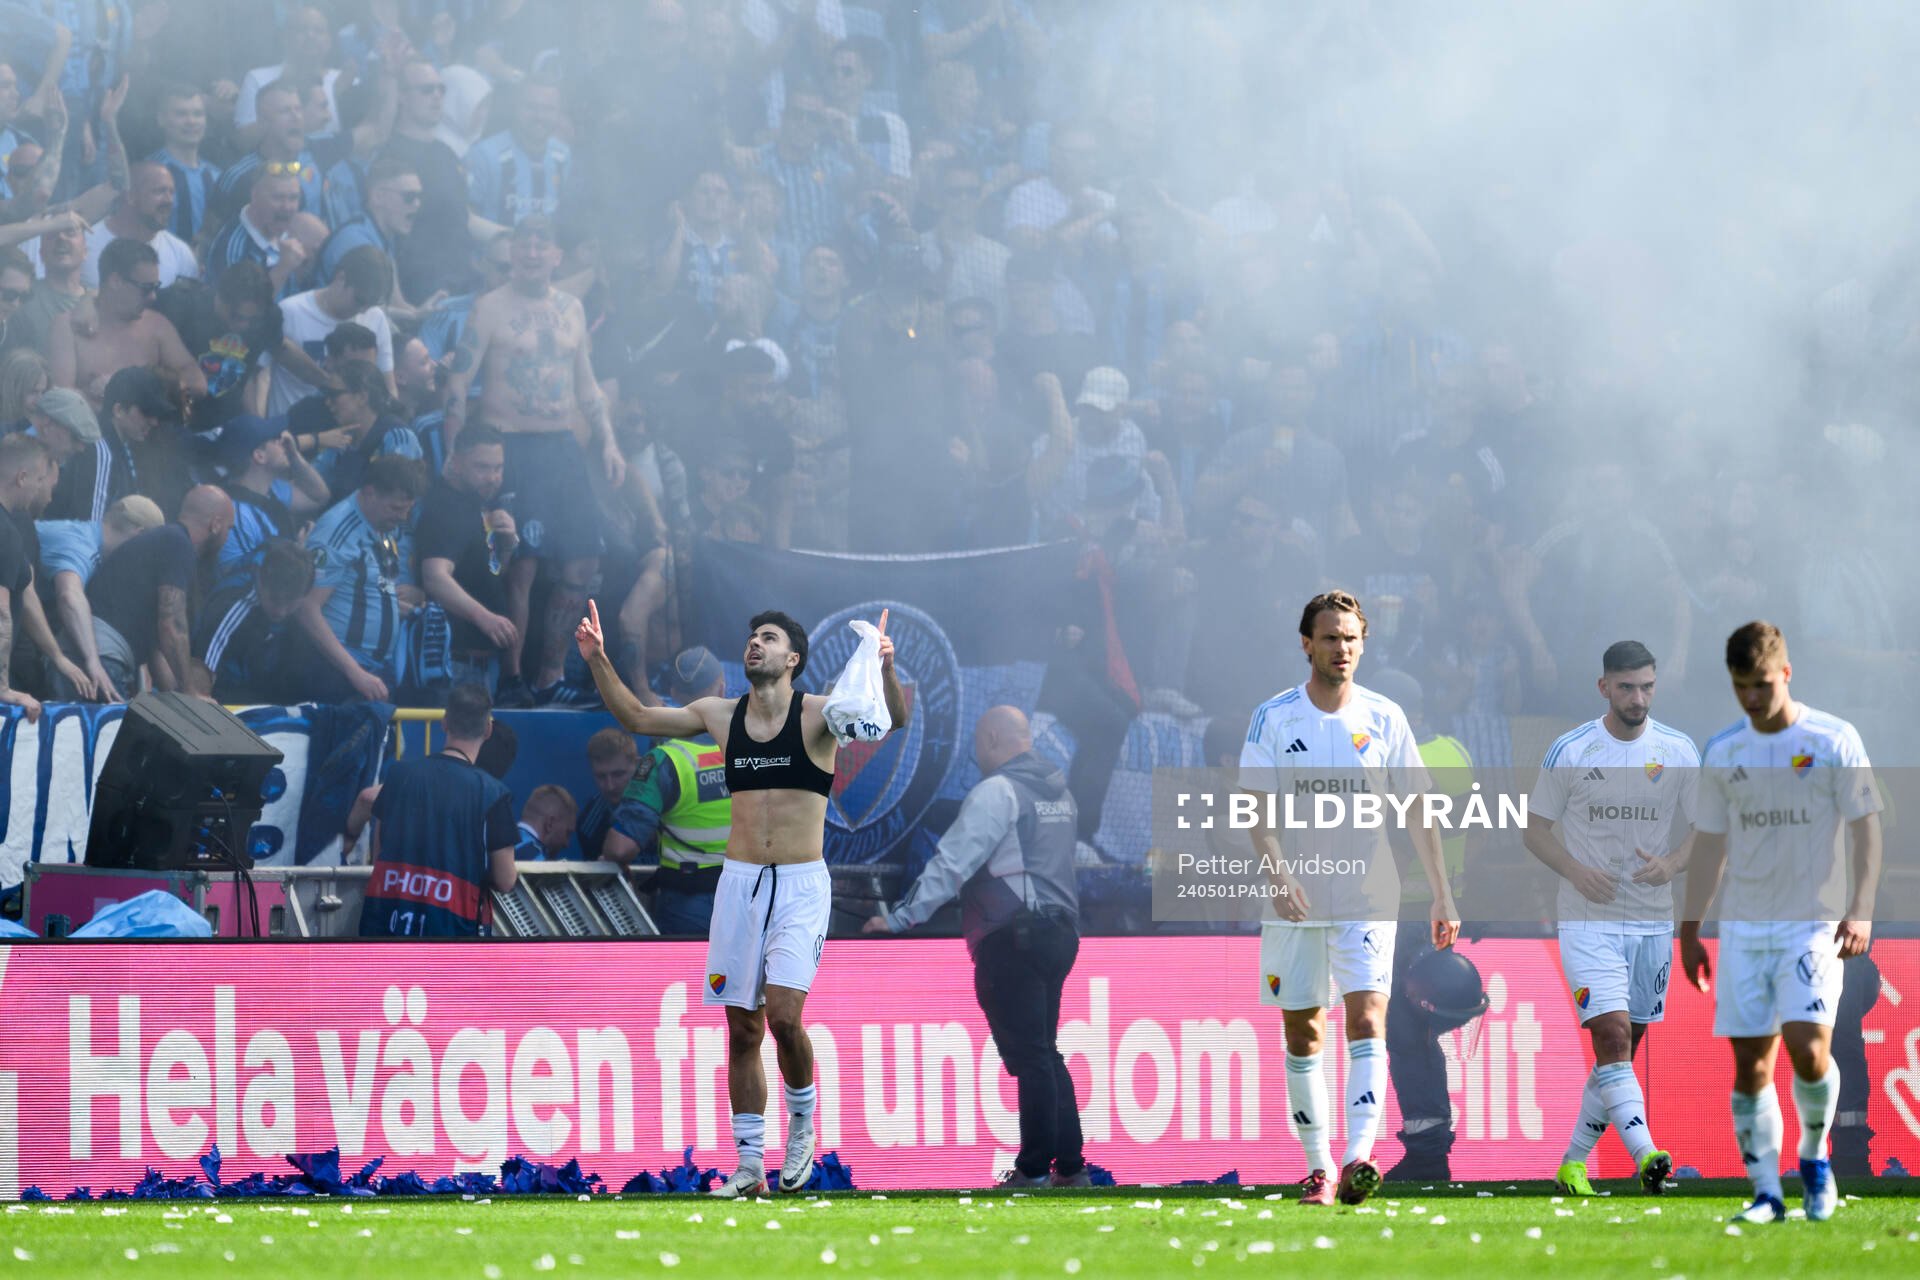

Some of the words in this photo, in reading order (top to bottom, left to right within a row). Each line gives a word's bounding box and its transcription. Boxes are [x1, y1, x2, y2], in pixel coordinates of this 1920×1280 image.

[1294, 779, 1371, 796] MOBILL
[1588, 805, 1659, 822] MOBILL
[1740, 808, 1811, 831] MOBILL
[383, 869, 452, 902] PHOTO
[69, 985, 296, 1159] Hela
[315, 985, 635, 1182] vägen
[654, 981, 842, 1152] frn
